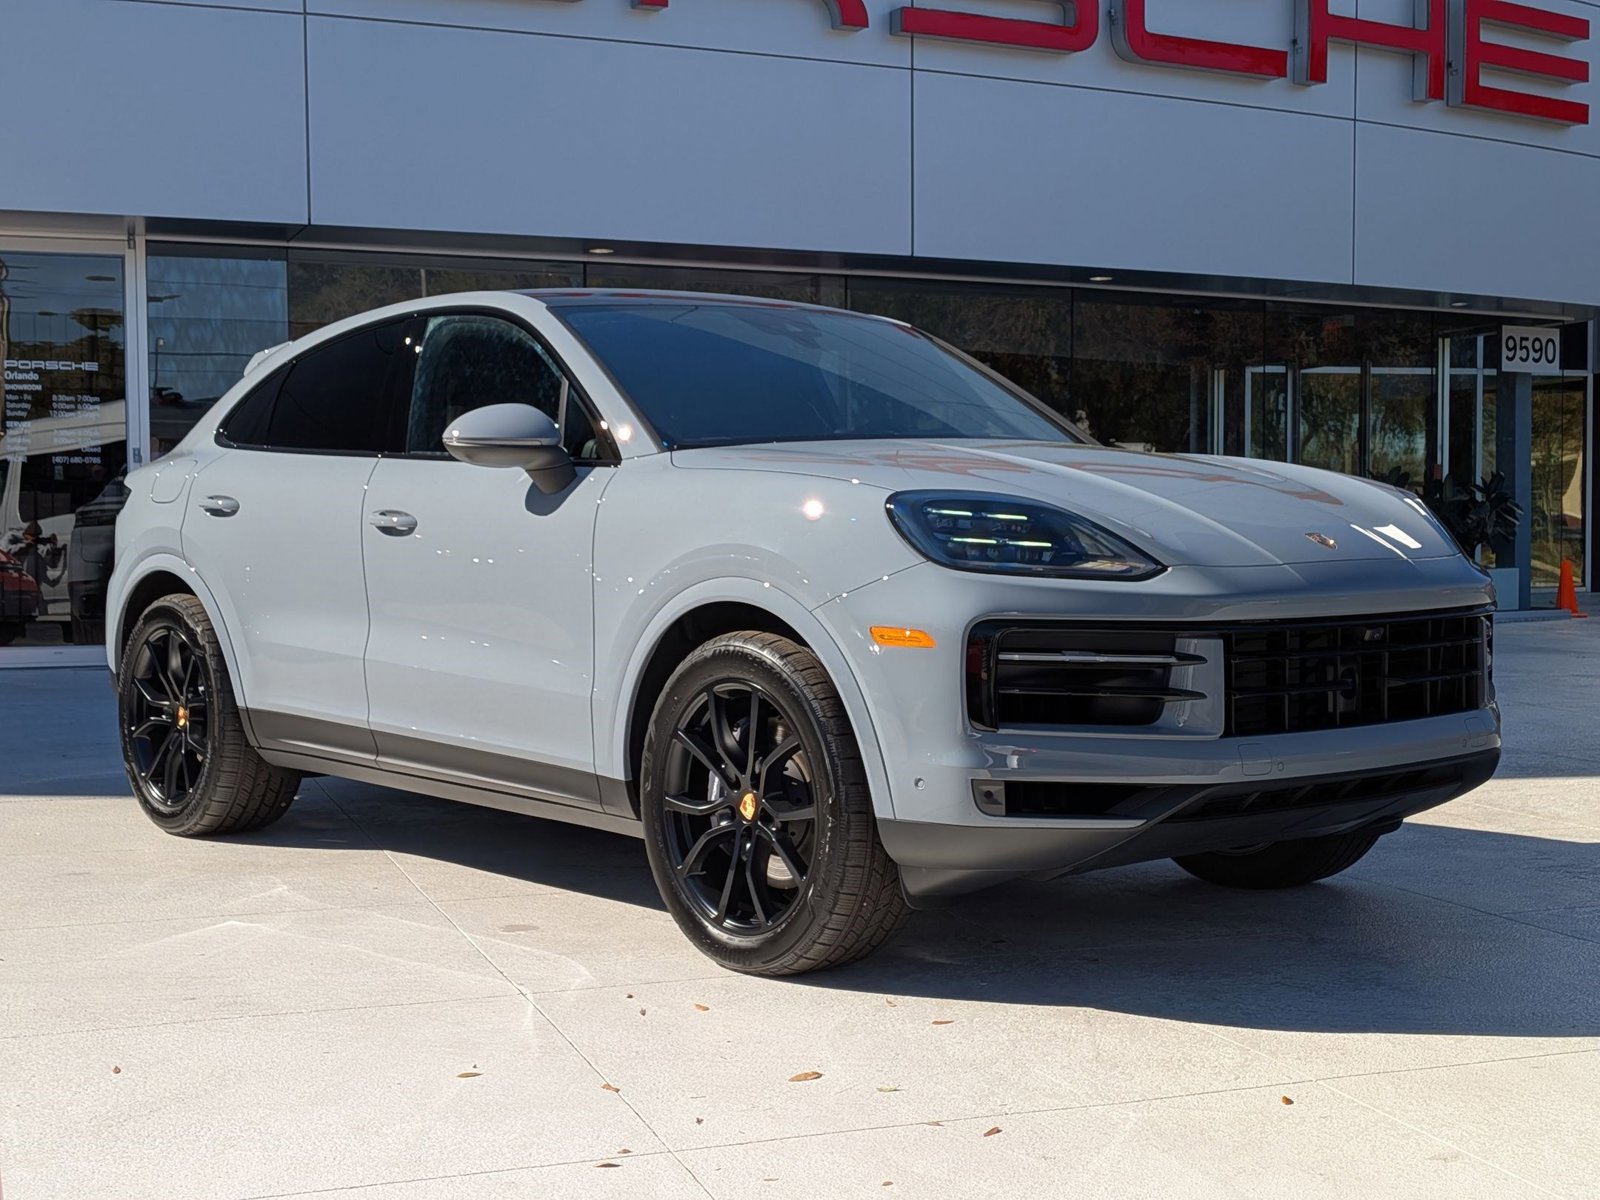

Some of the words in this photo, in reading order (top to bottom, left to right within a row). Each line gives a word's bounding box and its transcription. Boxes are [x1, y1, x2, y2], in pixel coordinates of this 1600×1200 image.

[1505, 335, 1557, 364] 9590
[4, 360, 99, 371] PORSCHE
[4, 371, 39, 381] Orlando
